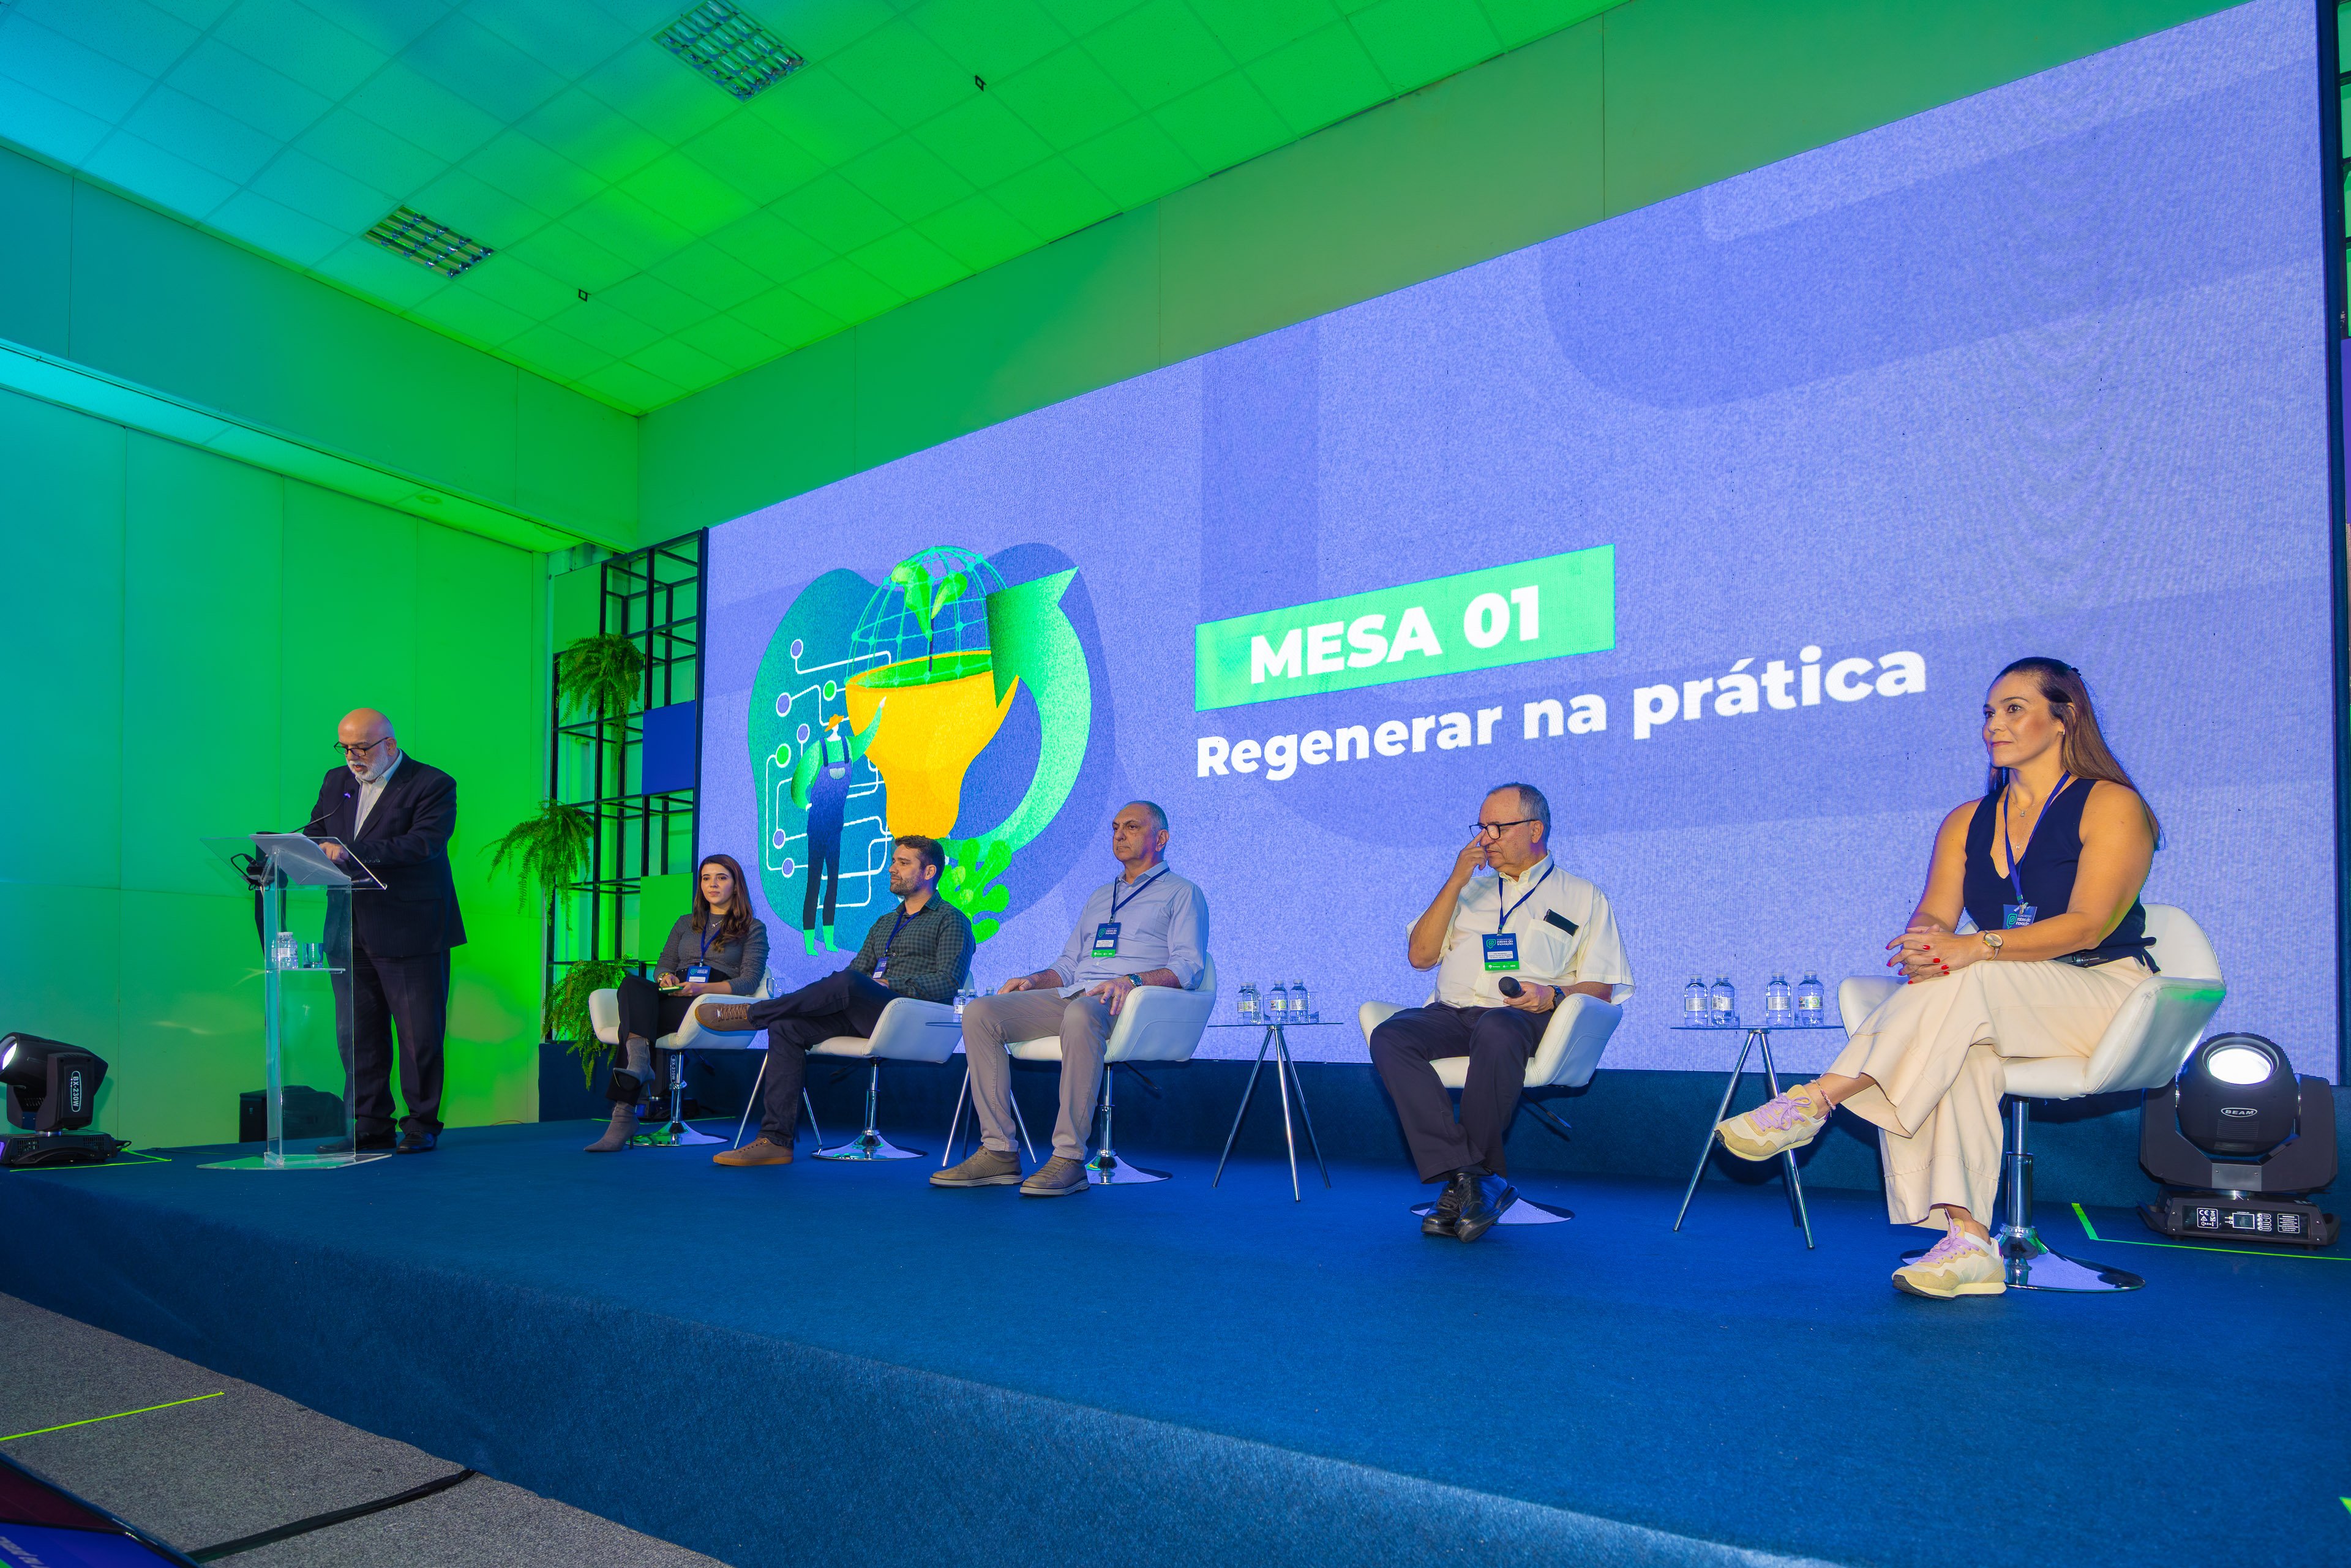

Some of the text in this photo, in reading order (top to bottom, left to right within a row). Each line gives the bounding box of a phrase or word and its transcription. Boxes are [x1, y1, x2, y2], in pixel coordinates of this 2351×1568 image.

[1250, 585, 1539, 684] MESA 01
[1197, 645, 1927, 781] Regenerar na prática
